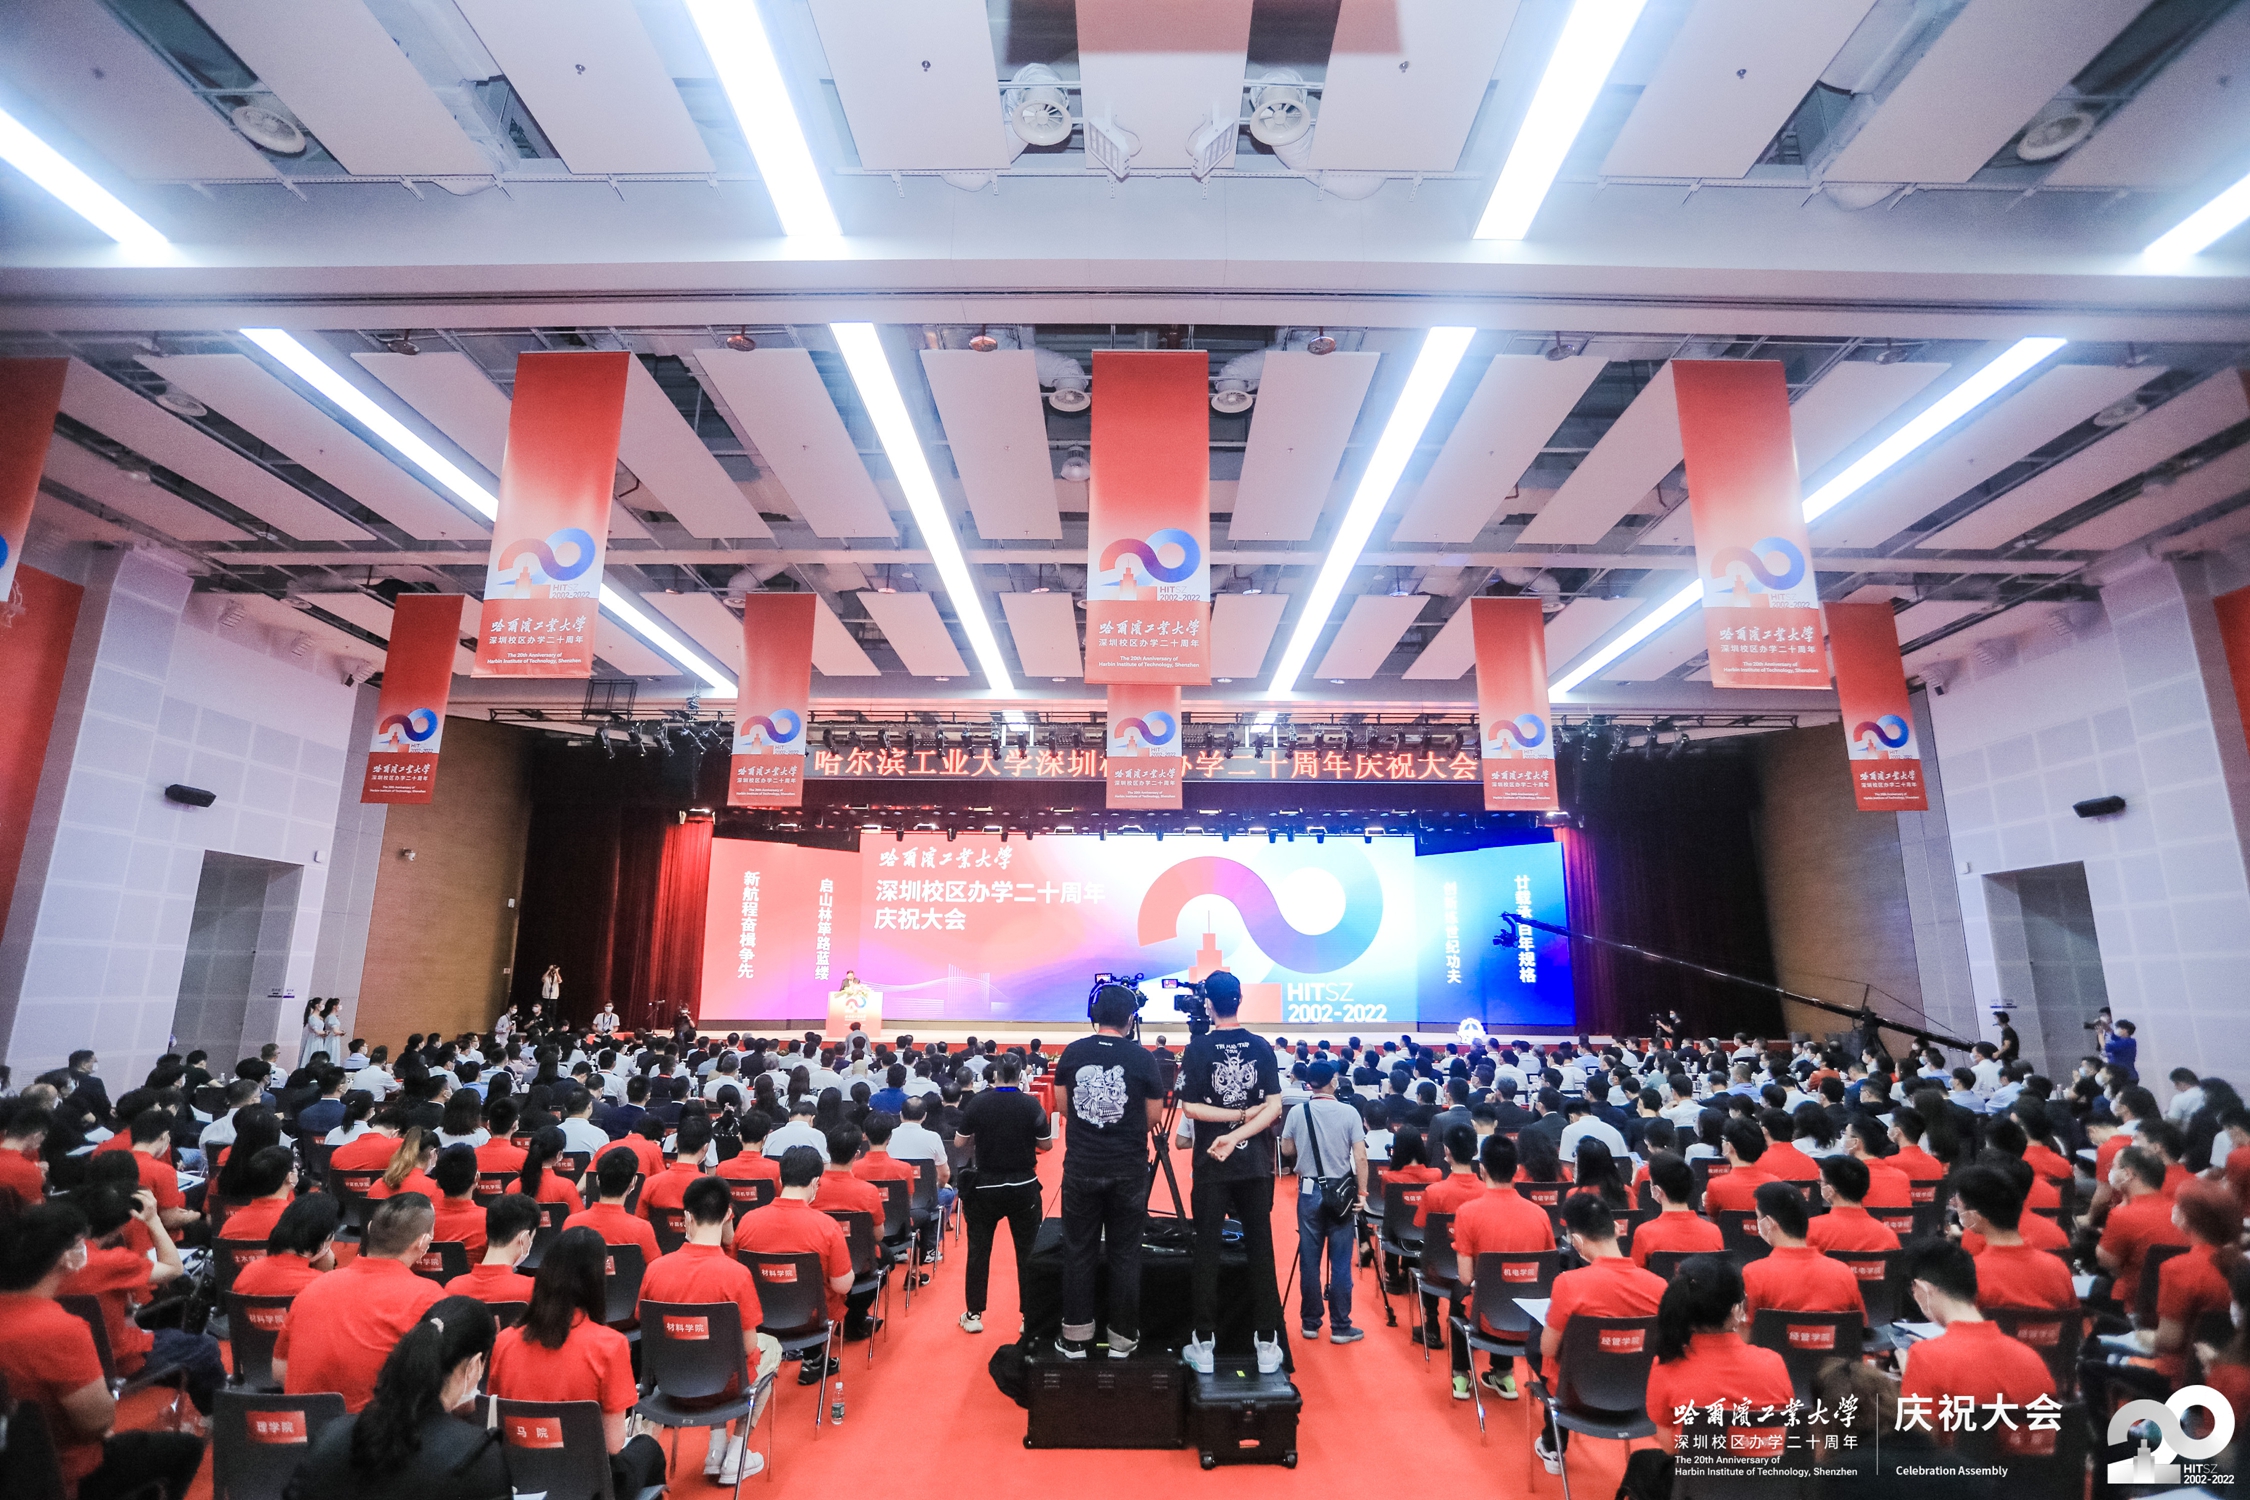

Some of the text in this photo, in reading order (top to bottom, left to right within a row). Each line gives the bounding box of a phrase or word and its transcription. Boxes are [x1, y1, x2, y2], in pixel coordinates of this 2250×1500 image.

[489, 635, 584, 644] 深圳校区办学二十周年
[1098, 638, 1200, 647] 深圳校区办学二十周年
[1720, 645, 1816, 654] 深圳校区办学二十周年
[876, 879, 1106, 905] 深圳校区办学二十周年
[737, 870, 761, 979] 新航程奋楫争先
[874, 908, 966, 932] 庆祝大会
[1287, 982, 1355, 1002] HITSZ
[1287, 1003, 1388, 1022] 2002-2022
[761, 1269, 793, 1277] 材料学院
[1503, 1268, 1535, 1276] 机电学院
[666, 1322, 704, 1332] 材料学院
[1601, 1336, 1640, 1346] 经管学院
[1789, 1331, 1831, 1342] 经管学院
[256, 1421, 293, 1433] 理学院
[517, 1425, 549, 1439] 马院
